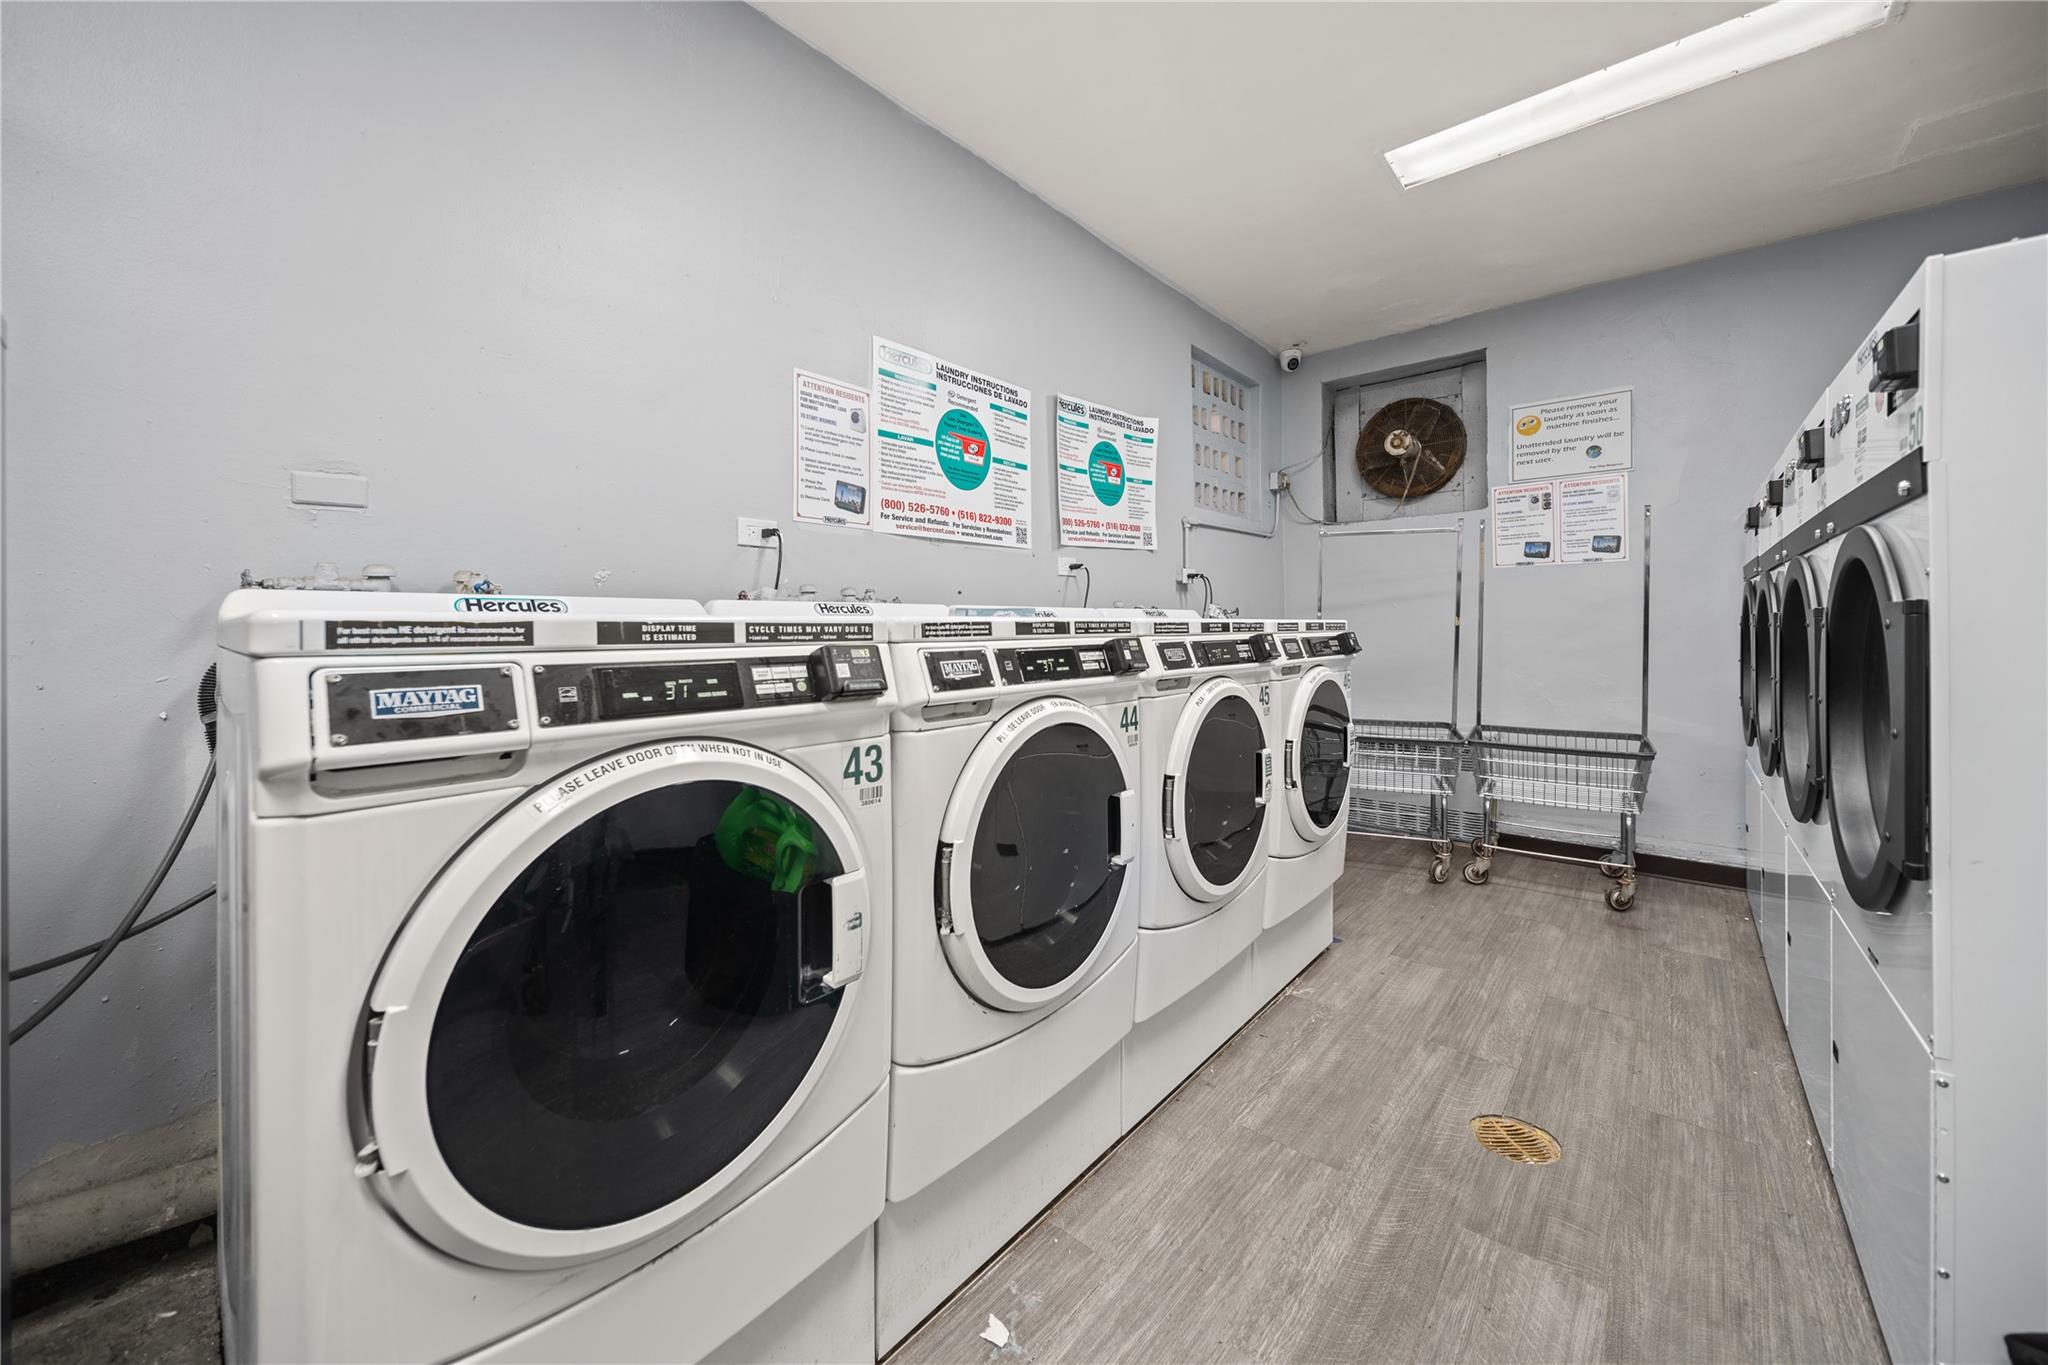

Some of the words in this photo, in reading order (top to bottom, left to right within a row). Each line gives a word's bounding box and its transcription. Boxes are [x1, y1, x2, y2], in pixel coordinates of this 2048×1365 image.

[936, 362, 969, 380] LAUNDRY
[971, 375, 1018, 397] INSTRUCTIONS
[803, 380, 835, 396] ATTENTION
[835, 389, 865, 403] RESIDENTS
[936, 371, 992, 396] INSTRUCCIONES
[994, 391, 1003, 400] DE
[1004, 395, 1028, 408] LAVADO
[1540, 406, 1566, 415] Please
[1566, 401, 1597, 410] remove
[1598, 398, 1618, 408] your
[1088, 406, 1111, 417] LAUNDRY
[1112, 412, 1144, 426] INSTRUCTIONS
[1544, 413, 1573, 422] laundry
[1587, 409, 1607, 417] soon
[1089, 413, 1125, 428] INSTRUCCIONES
[1133, 425, 1154, 434] LAVADO
[1546, 421, 1580, 430] machine
[1516, 438, 1562, 450] Unattended
[1564, 434, 1595, 445] laundry
[1597, 431, 1612, 439] will
[1516, 448, 1550, 458] removed
[1551, 446, 1561, 455] by
[1563, 444, 1577, 452] the
[1535, 456, 1554, 464] user.
[1524, 485, 1549, 493] RESIDENTS
[1563, 480, 1591, 489] ATTENTION
[1592, 478, 1620, 486] RESIDENTS
[880, 512, 890, 520] For
[892, 514, 913, 522] Service
[928, 518, 950, 526] Refunds:
[881, 498, 905, 513] (800)
[908, 502, 950, 517] 526-5760
[958, 509, 977, 522] (516)
[979, 513, 1012, 526] 822-9300
[896, 523, 956, 535] service@hercnet.com
[961, 531, 1003, 541] www.hercnet.com
[961, 523, 982, 531] Servicios
[1074, 519, 1100, 528] 526-5760
[1106, 522, 1119, 531] (516)
[1119, 523, 1141, 532] 822-9300
[465, 598, 561, 613] Hercules
[818, 603, 870, 615] Hercules
[337, 627, 351, 635] For
[352, 627, 370, 635] best
[399, 625, 413, 634] HE
[413, 625, 456, 635] detergent
[641, 624, 676, 632] DISPLAY
[678, 624, 697, 632] TIME
[749, 625, 775, 633] CYCLE
[779, 625, 803, 633] TIMES
[805, 625, 821, 633] MAY
[824, 625, 842, 633] VARY
[845, 625, 858, 633] DUE
[861, 625, 873, 633] TO:
[371, 636, 412, 645] detergents
[944, 662, 977, 673] MAYTAG
[376, 689, 477, 709] MAYTAG
[1259, 686, 1270, 706] 45
[394, 703, 463, 714] COMMERCIAL
[1016, 710, 1032, 725] LEAVE
[1032, 703, 1046, 716] DOOR
[1120, 705, 1138, 733] 44
[584, 758, 626, 783] LEAVE
[626, 746, 663, 766] DOOR
[697, 744, 730, 754] WHEN
[732, 747, 751, 759] NOT
[754, 751, 764, 761] IN
[766, 756, 783, 769] USE
[843, 744, 883, 786] 43
